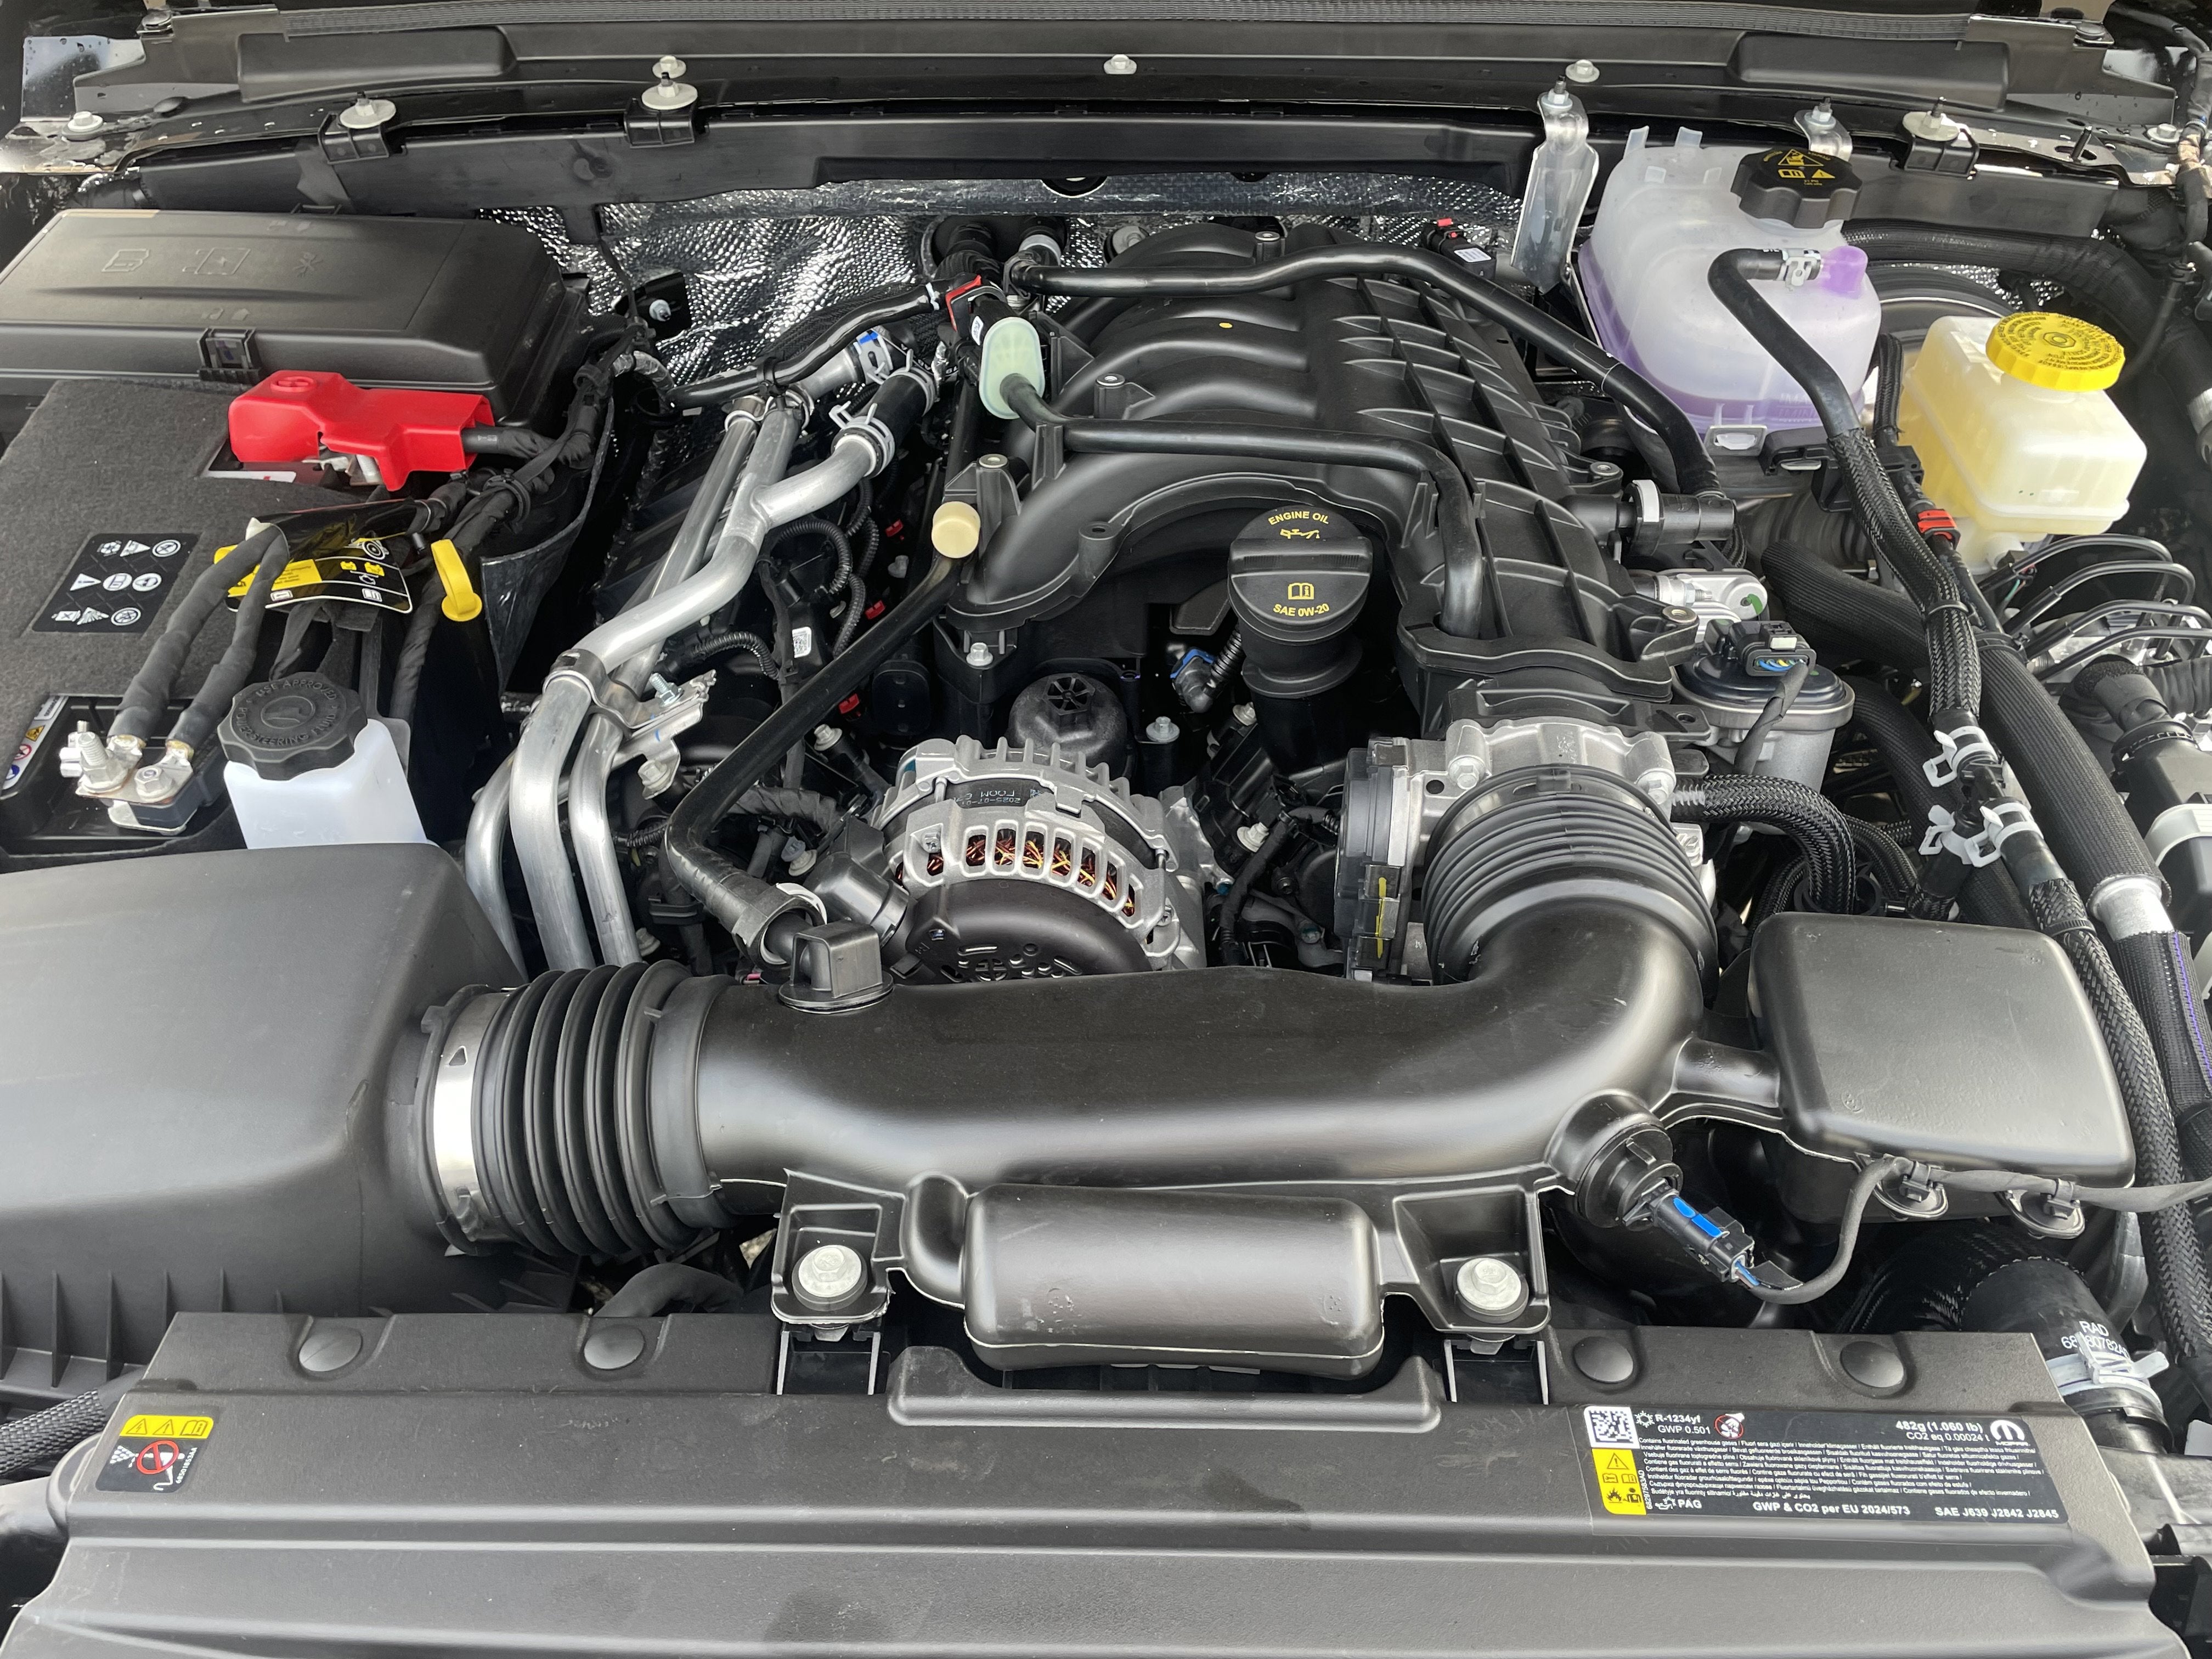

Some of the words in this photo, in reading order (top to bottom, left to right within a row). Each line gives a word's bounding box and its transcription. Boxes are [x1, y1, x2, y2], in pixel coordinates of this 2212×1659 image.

[1268, 511, 1310, 526] ENGINE
[1312, 512, 1330, 524] OIL
[1273, 603, 1296, 617] SAE
[1297, 602, 1330, 617] 0W-20
[255, 683, 278, 697] USE
[283, 679, 337, 701] APPROVED
[250, 733, 310, 746] STEERING
[311, 713, 336, 735] FLUID
[2079, 1321, 2109, 1336] RAD
[1657, 1425, 1683, 1434] GWP
[1684, 1426, 1711, 1435] 0.501
[1895, 1420, 1926, 1432] 482g
[1927, 1421, 1964, 1432] (1.060
[1965, 1423, 1983, 1434] lb)
[1906, 1432, 1929, 1440] CO2
[1931, 1433, 1945, 1442] eq
[1945, 1432, 1984, 1442] 0.00024
[1677, 1499, 1702, 1509] PAG
[1752, 1501, 1781, 1511] GWP
[1783, 1502, 1793, 1512] &
[1794, 1503, 1820, 1513] CO2
[1821, 1505, 1840, 1514] per
[1841, 1504, 1859, 1514] EU
[1861, 1505, 1911, 1515] 2024/573
[1934, 1506, 1960, 1516] SAE
[1962, 1508, 1989, 1517] J639
[1991, 1508, 2024, 1518] J2842
[2026, 1509, 2059, 1519] J2845
